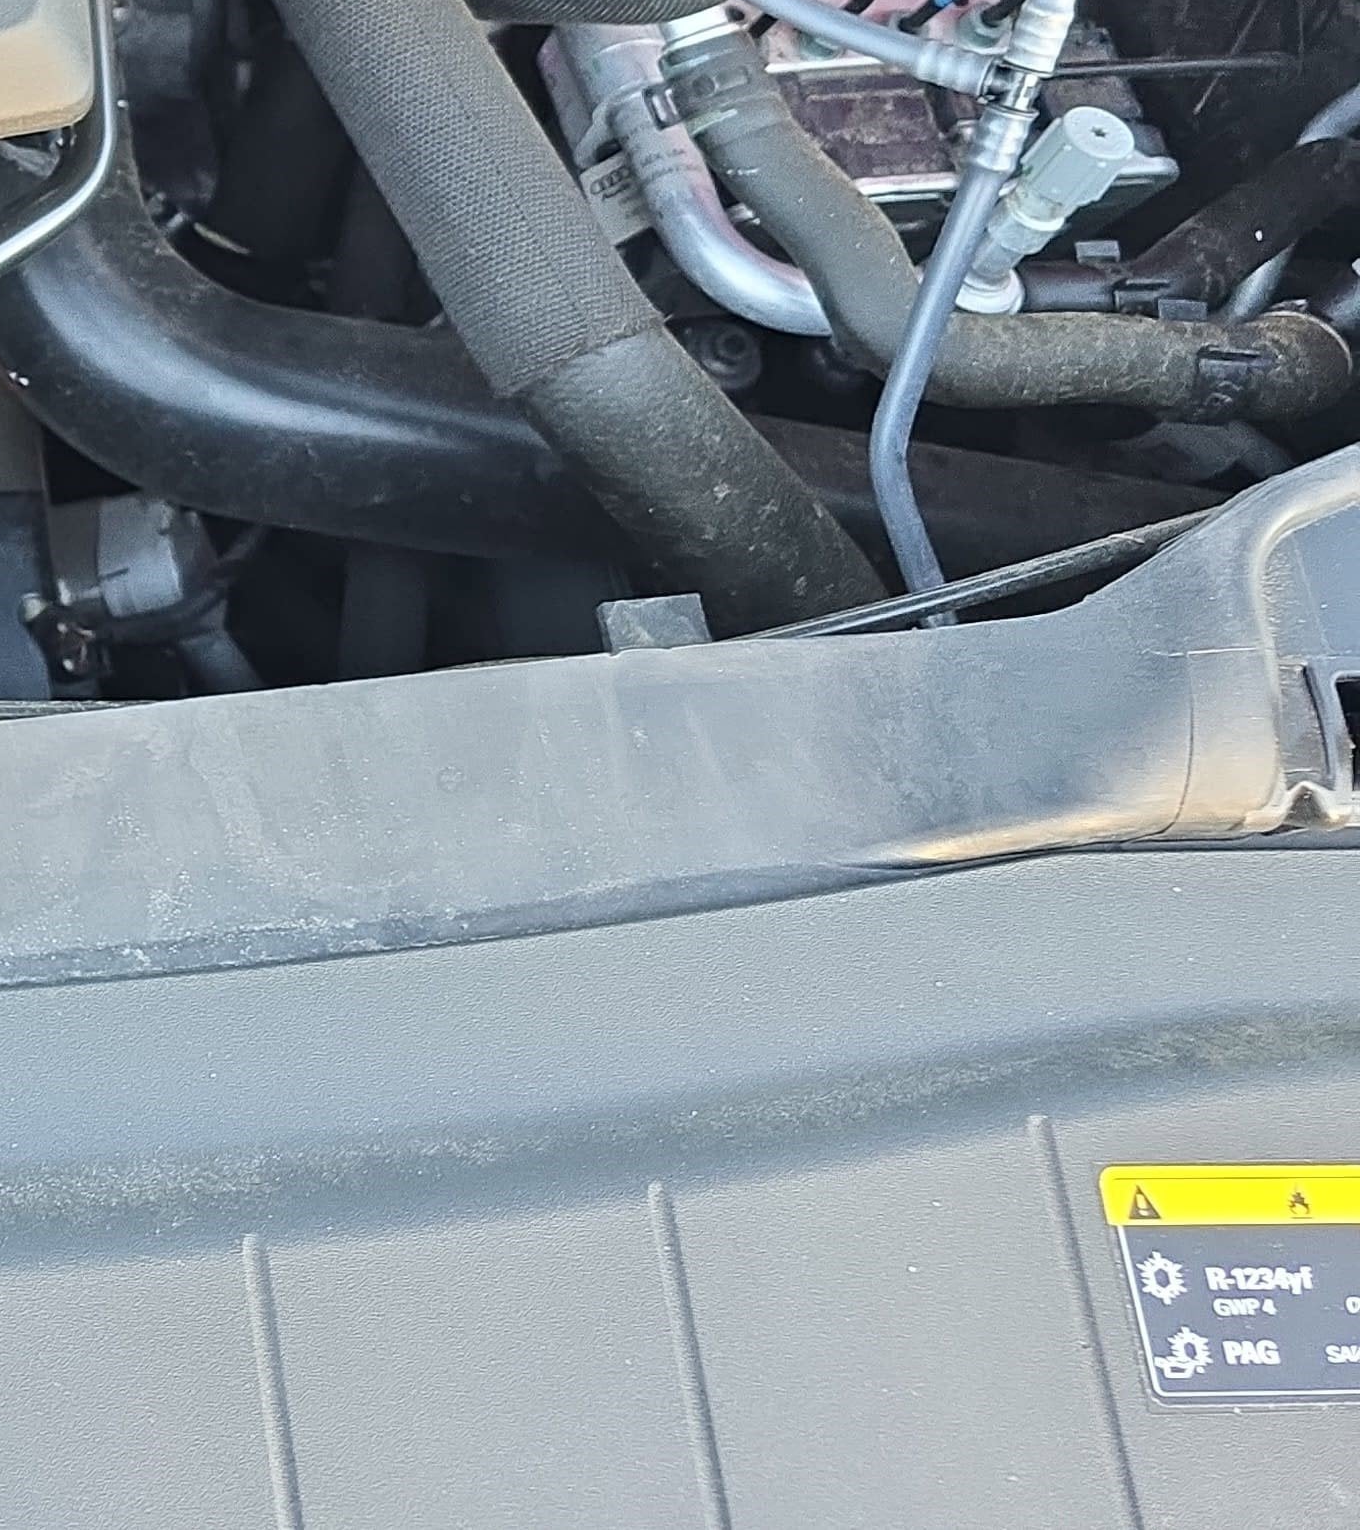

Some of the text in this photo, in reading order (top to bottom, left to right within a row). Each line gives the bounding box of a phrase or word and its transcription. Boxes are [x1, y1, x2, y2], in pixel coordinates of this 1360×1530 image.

[1205, 1266, 1314, 1295] R-1234yf
[1212, 1298, 1260, 1316] GWP
[1260, 1297, 1278, 1317] 4
[1221, 1339, 1282, 1366] PAG
